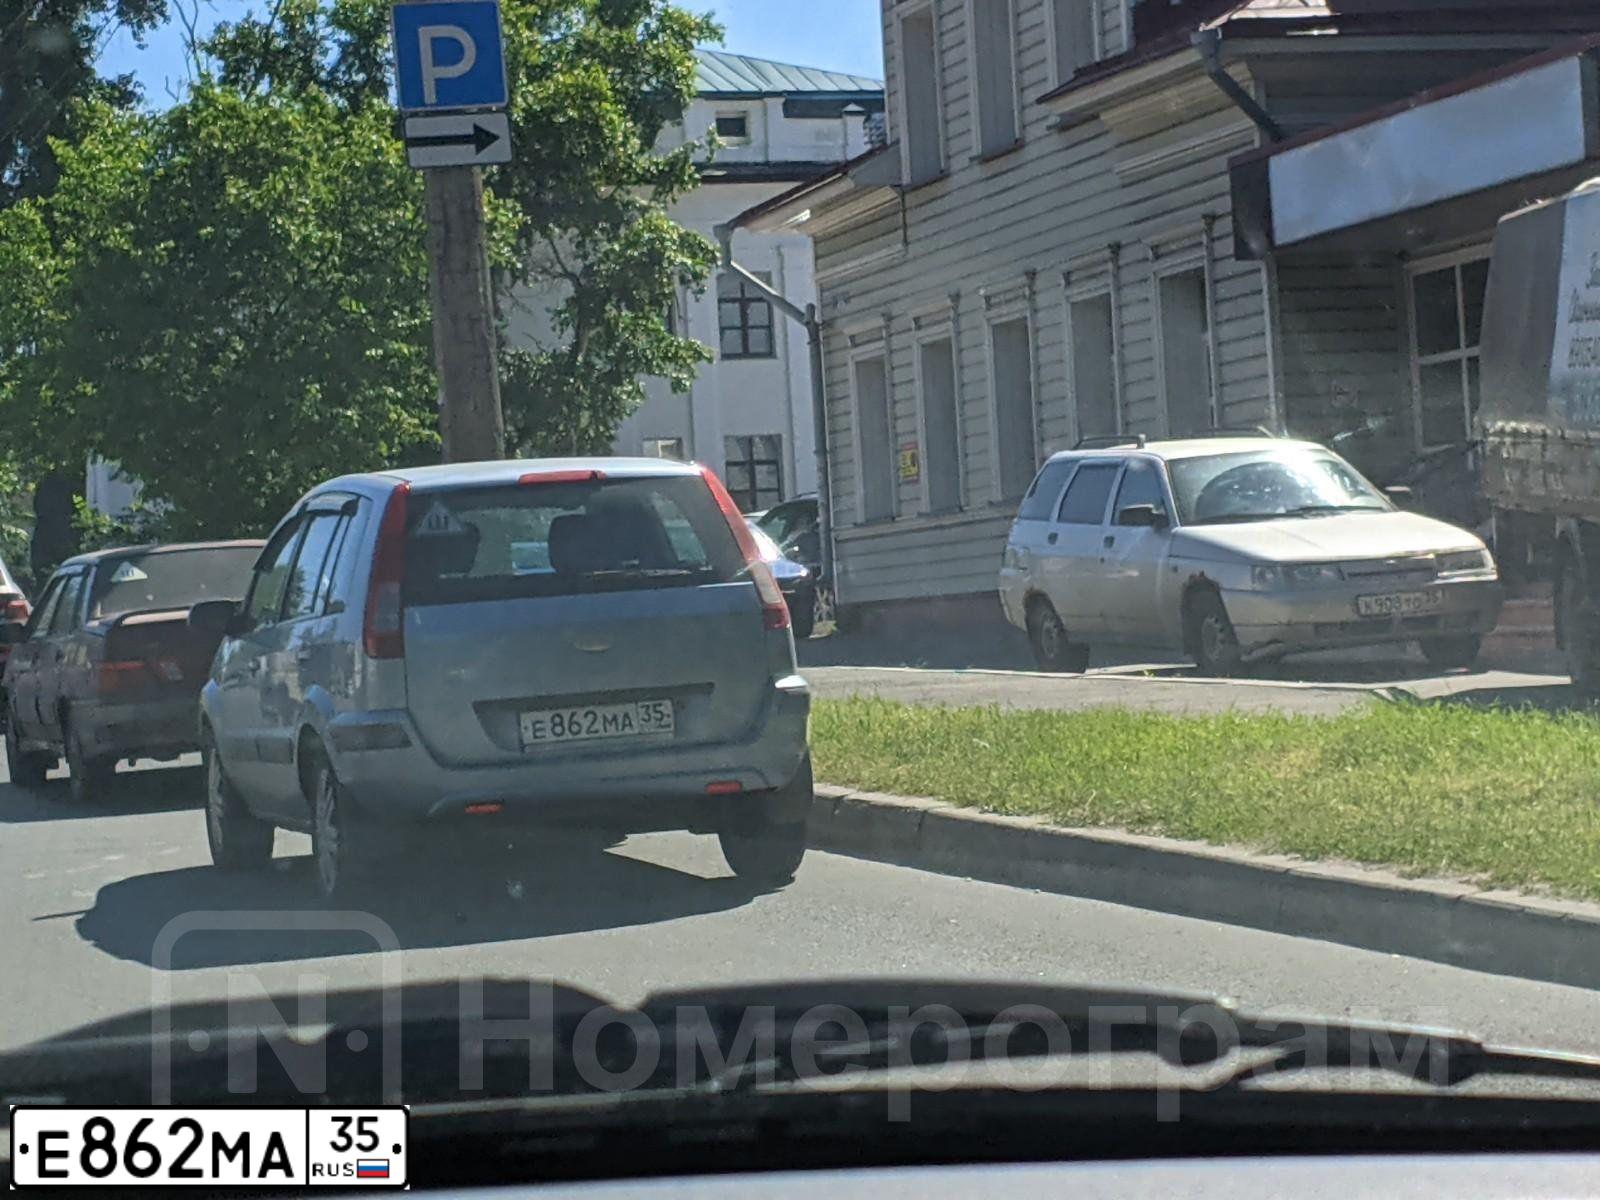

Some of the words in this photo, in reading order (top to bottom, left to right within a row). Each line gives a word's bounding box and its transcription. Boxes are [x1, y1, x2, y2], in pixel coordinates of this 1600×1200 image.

[418, 24, 476, 105] P
[531, 710, 634, 740] Е862МА
[639, 703, 666, 723] 35
